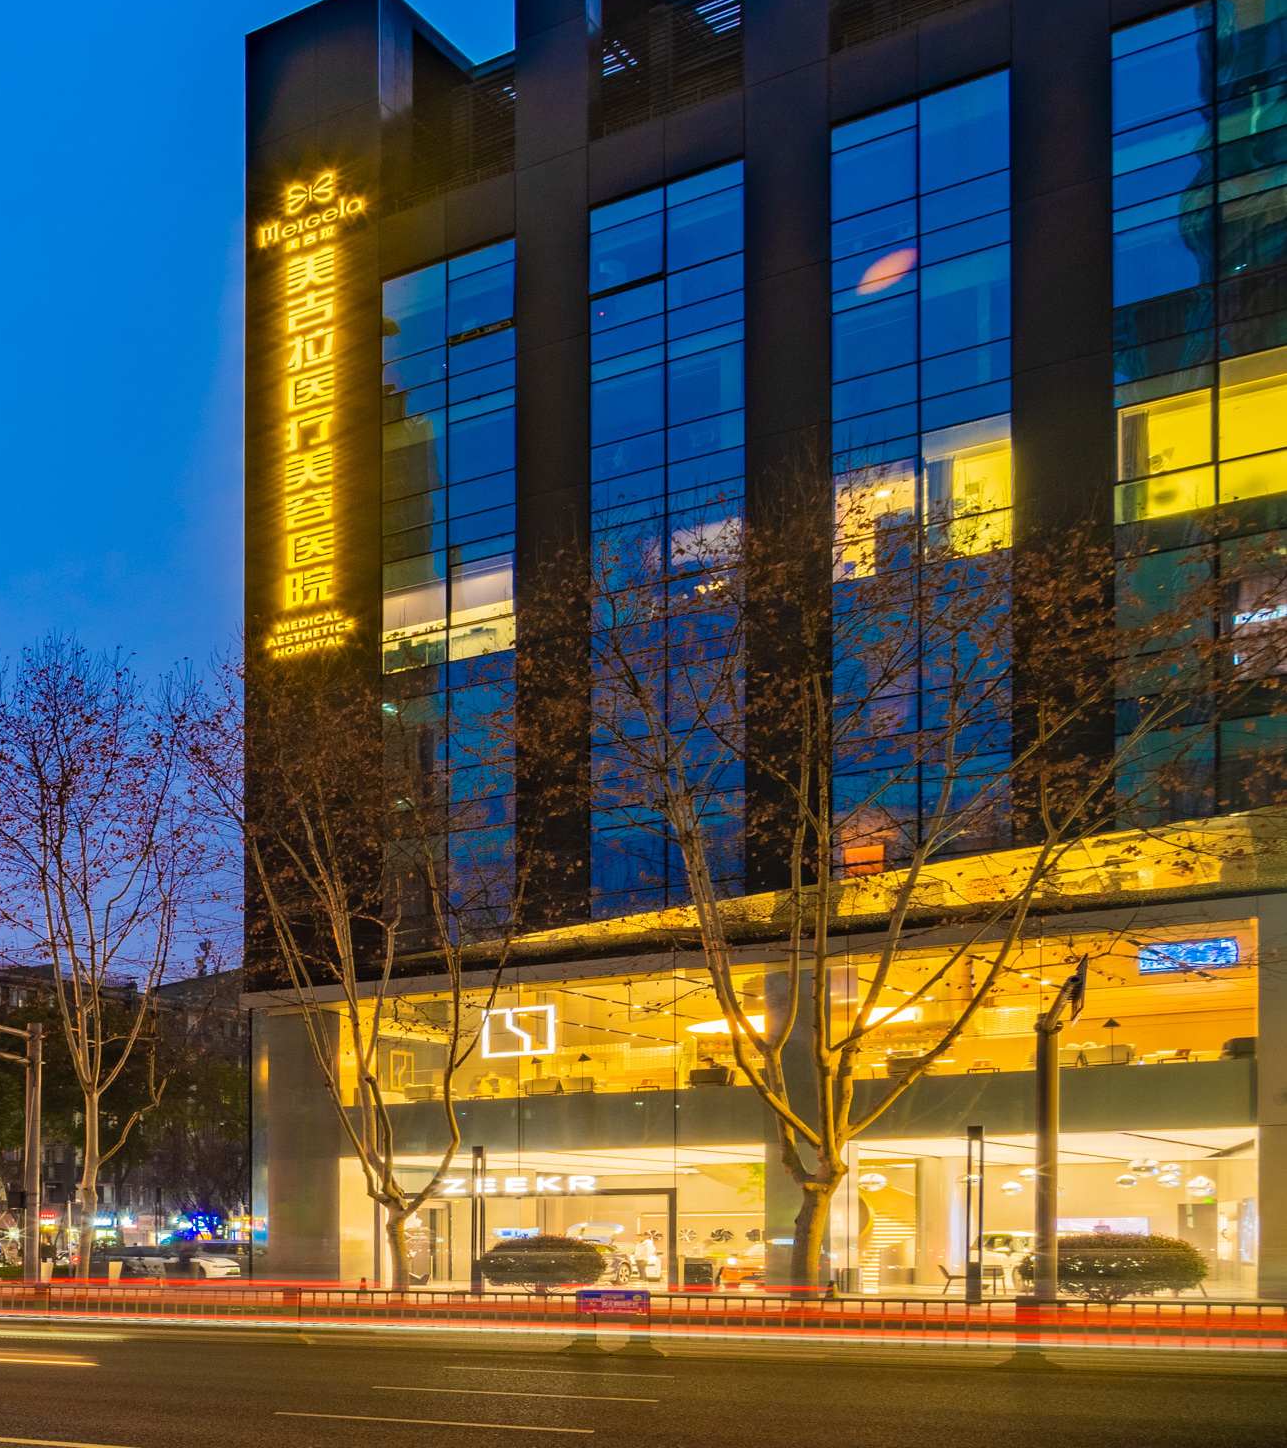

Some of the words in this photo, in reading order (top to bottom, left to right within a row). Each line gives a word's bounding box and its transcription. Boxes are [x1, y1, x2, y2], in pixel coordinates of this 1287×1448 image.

[259, 197, 363, 247] Meigela
[286, 225, 335, 252] 美吉拉
[285, 246, 335, 609] 美吉拉医疗美容医院
[267, 621, 353, 648] AESTHETICS
[277, 611, 342, 634] MEDICAL
[275, 635, 344, 658] HOSPITAL
[443, 1175, 597, 1194] ZEEKR
